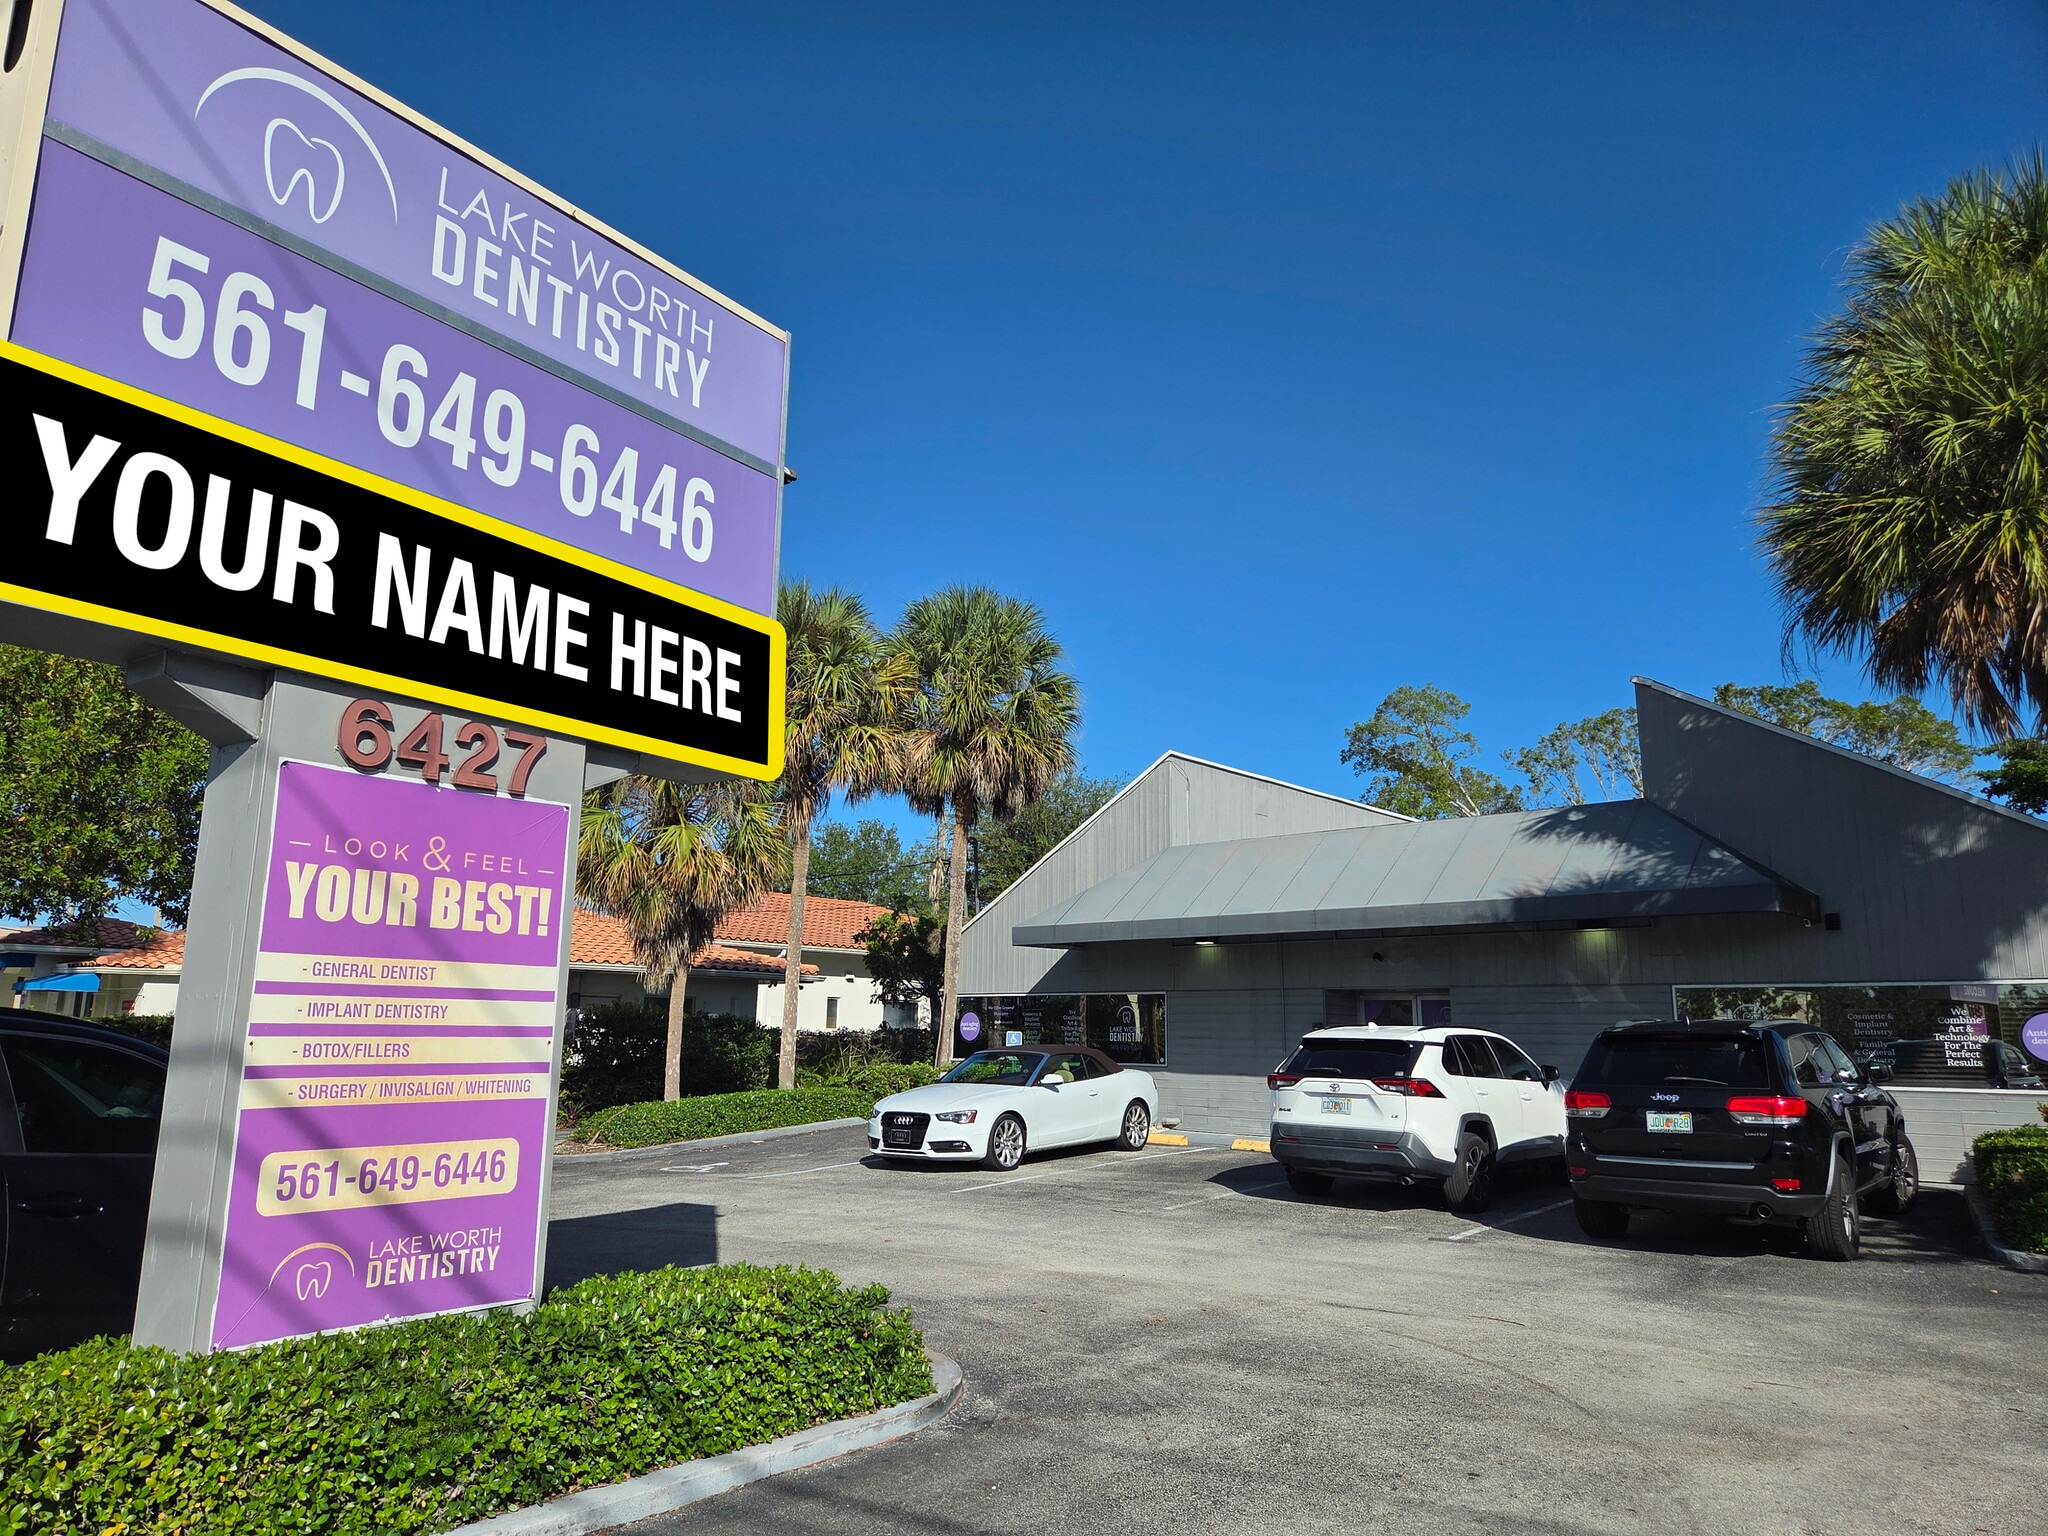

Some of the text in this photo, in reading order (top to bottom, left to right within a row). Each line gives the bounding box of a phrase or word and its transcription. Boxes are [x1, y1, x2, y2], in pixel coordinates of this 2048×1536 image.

[438, 166, 713, 353] LAKE WORTH
[432, 214, 710, 409] DENTISTRY
[142, 236, 715, 563] 561-649-6446
[337, 698, 547, 796] 6427
[324, 834, 528, 875] LOOK & FEEL
[285, 860, 552, 937] YOUR BEST!
[312, 961, 376, 978] GENERAL
[380, 965, 437, 981] DENTIST
[307, 1002, 371, 1018] IMPLANT
[374, 1003, 449, 1020] DENTISTRY
[1938, 1016, 1982, 1024] Combine
[1951, 1007, 1968, 1015] We
[1854, 1029, 1893, 1037] Dentistry
[1933, 1033, 1990, 1043] Technology
[1948, 1025, 1974, 1033] Art &
[302, 1043, 410, 1060] BOTOX/FILLERS
[1860, 1041, 1888, 1049] Family
[1944, 1041, 1982, 1050] For The
[1945, 1050, 1980, 1058] Perfect
[1947, 1059, 1983, 1067] Results
[298, 1083, 367, 1100] SURGERY
[379, 1081, 454, 1097] INVISALIGN
[465, 1079, 531, 1095] WHITENING
[1650, 1092, 1679, 1102] Jeep
[276, 1150, 506, 1202] 561-649-6446
[369, 1226, 502, 1259] LAKE WORTH
[365, 1245, 500, 1288] DENTISTRY
